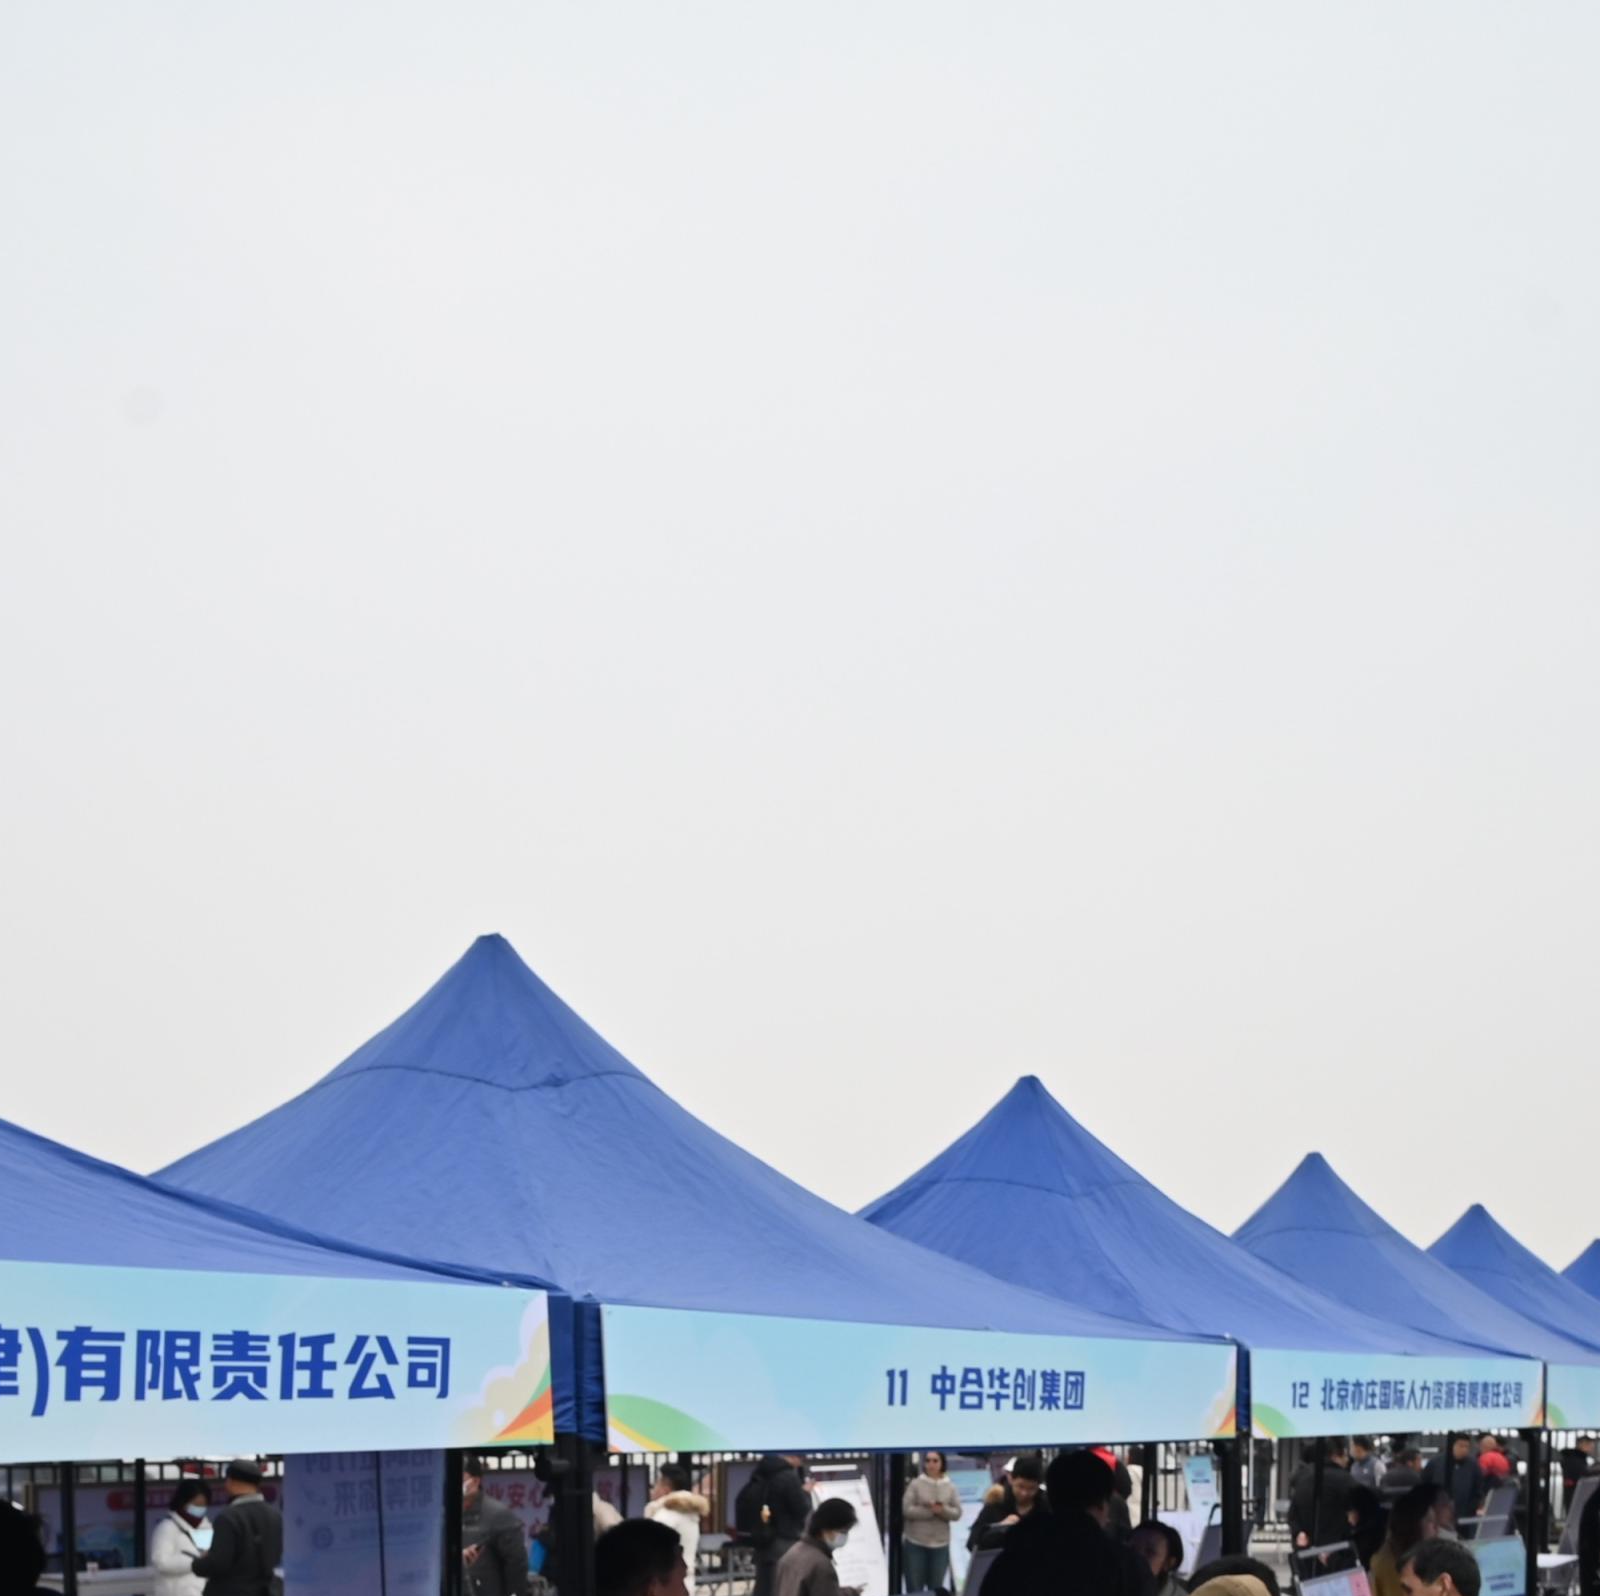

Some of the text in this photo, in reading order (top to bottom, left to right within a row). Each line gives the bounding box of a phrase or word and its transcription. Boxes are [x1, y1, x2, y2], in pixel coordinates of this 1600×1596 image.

[885, 1365, 1087, 1412] 11 中合华创集团
[1291, 1377, 1524, 1412] 12 北京亦庄国际人力资源有限责任公司
